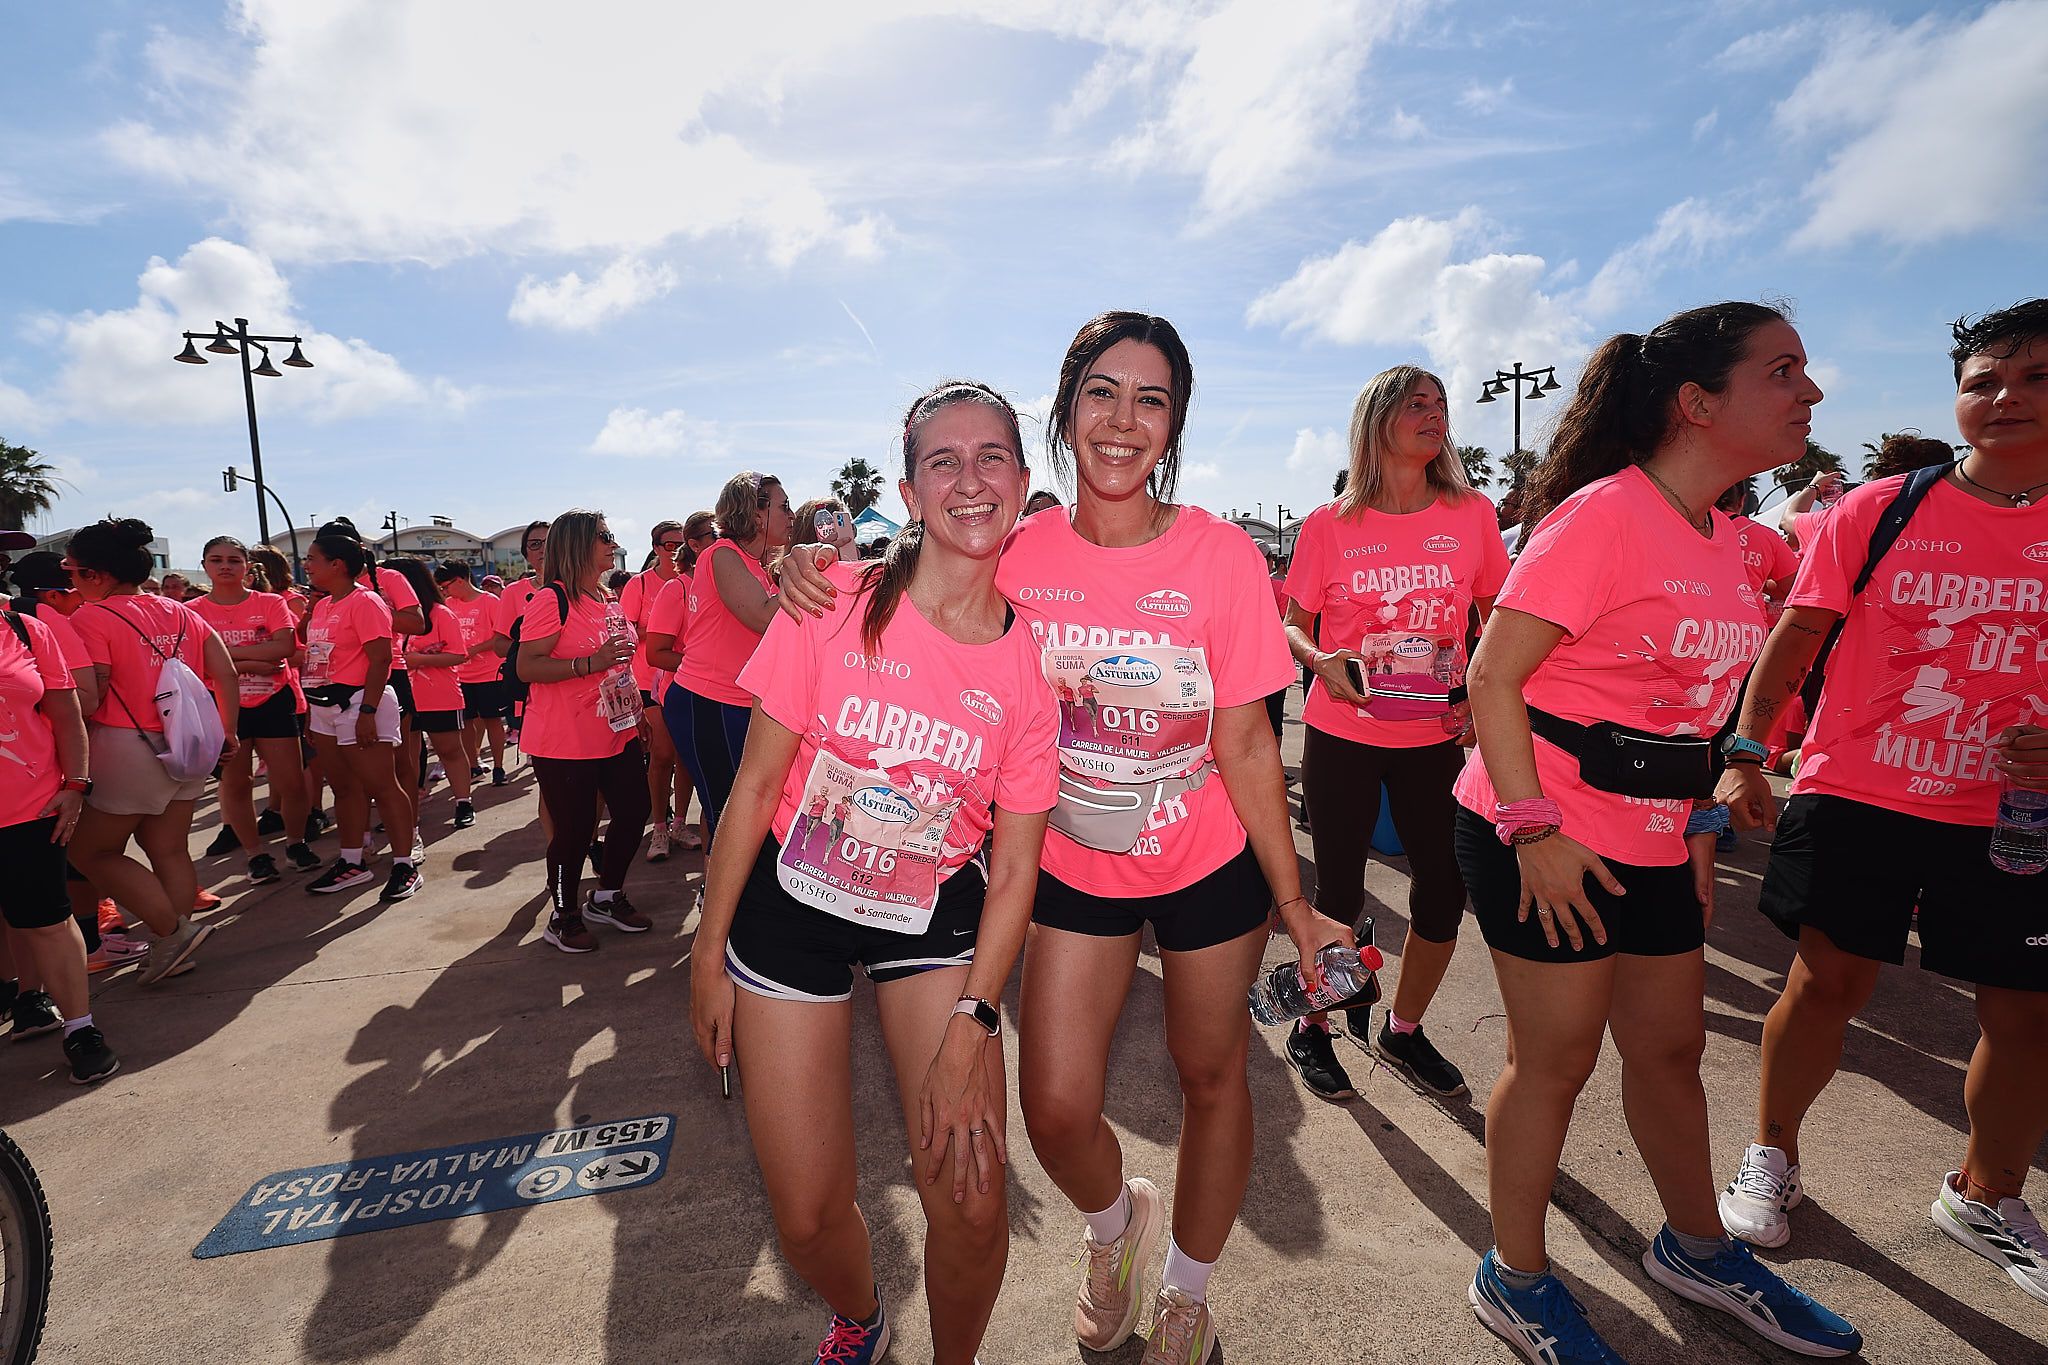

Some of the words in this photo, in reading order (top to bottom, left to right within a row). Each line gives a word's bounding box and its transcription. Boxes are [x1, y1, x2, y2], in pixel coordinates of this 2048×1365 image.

[1344, 543, 1387, 559] OYSHO
[1895, 539, 1962, 554] OYSHO
[1352, 564, 1455, 594] CARRERA
[1019, 587, 1085, 602] OYSHO
[1891, 570, 2048, 613] CARRER
[1396, 645, 1431, 654] ASTURIANA
[1671, 618, 1768, 662] CARRER
[844, 651, 911, 680] OYSHO
[1056, 661, 1085, 670] SUMA
[1096, 667, 1155, 680] ASTURIANA
[1102, 707, 1160, 733] 016
[835, 695, 983, 777] CARRERA
[1121, 734, 1140, 747] 611
[1072, 740, 1102, 751] CARRERA
[1104, 744, 1115, 754] DE
[1115, 747, 1124, 755] LA
[1125, 749, 1150, 759] MUJER
[1157, 742, 1191, 757] VALENCIA
[1872, 731, 2001, 781] MUJER
[1071, 756, 1115, 773] OYSHO
[1146, 756, 1191, 775] Santander
[826, 770, 854, 790] SUMA
[1907, 776, 1957, 796] 2026
[857, 792, 913, 821] ASTURIANA
[841, 837, 898, 873] 016
[1127, 835, 1162, 856] 026
[899, 852, 937, 865] CORREDOR
[794, 860, 827, 881] CARRERA
[829, 875, 840, 887] DE
[840, 880, 850, 891] LA
[852, 885, 878, 899] MUJER
[885, 892, 917, 905] VALENCIA
[851, 870, 873, 886] 612
[790, 877, 837, 903] OYSHO
[866, 908, 912, 924] Santander
[595, 1121, 664, 1147] 455
[250, 1144, 532, 1207] MALVA-ROSA
[262, 1179, 484, 1235] HOSPITAL
